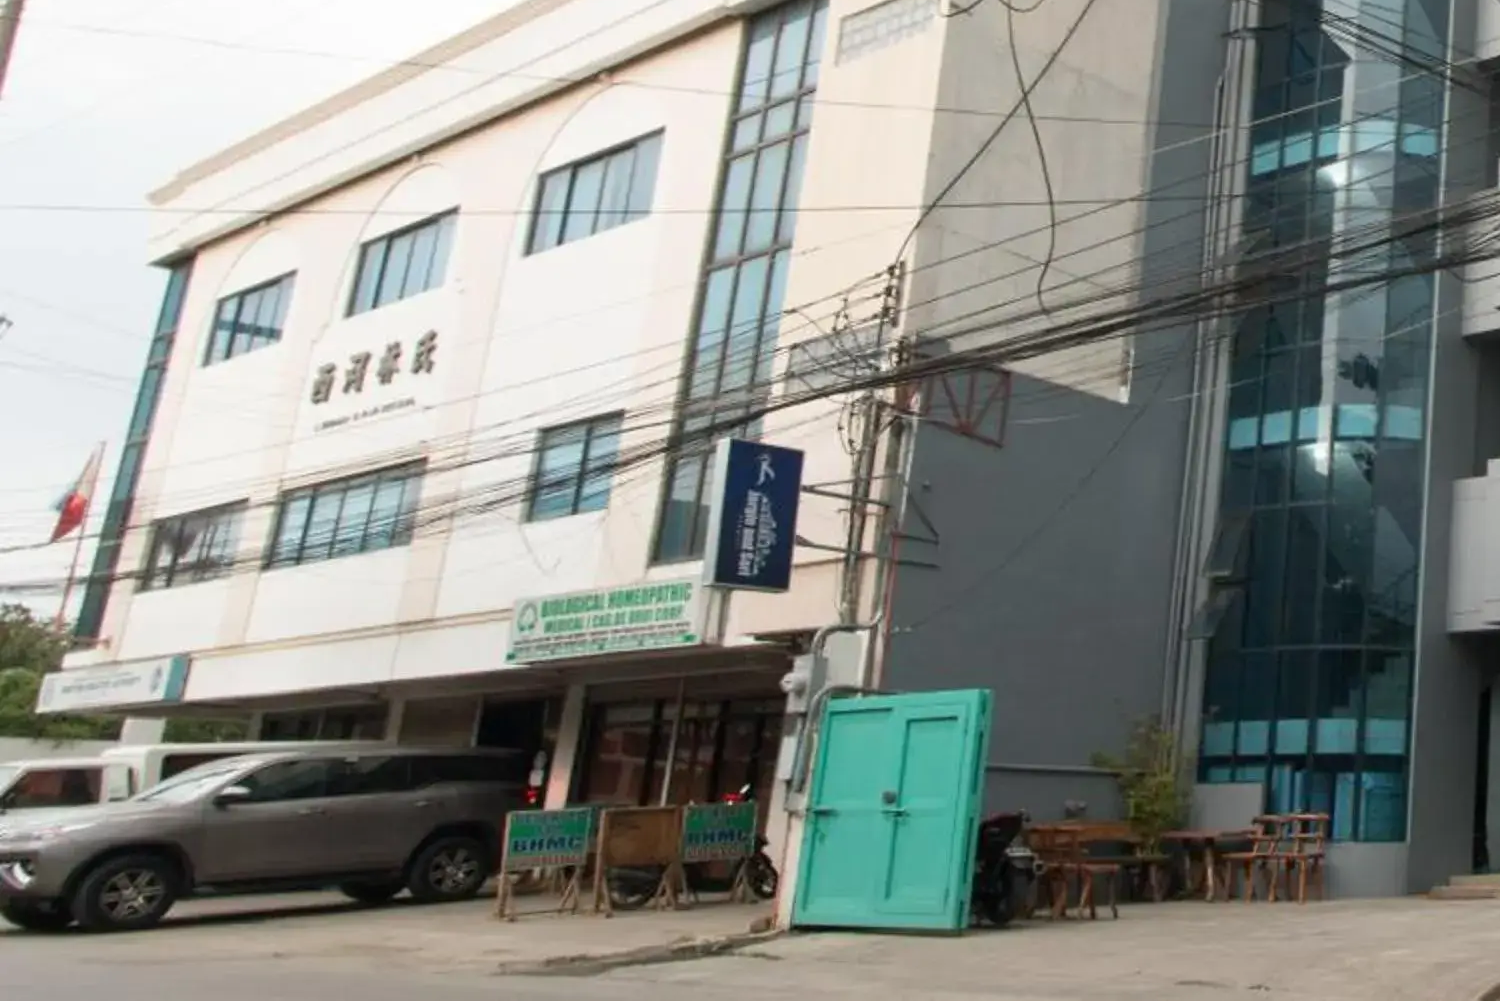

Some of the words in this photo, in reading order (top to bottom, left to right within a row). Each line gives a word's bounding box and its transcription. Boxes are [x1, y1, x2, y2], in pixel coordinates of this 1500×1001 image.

[540, 594, 605, 618] BIOLOGICAL
[608, 582, 693, 608] HOMEOPATHIC
[514, 836, 582, 852] BHMC
